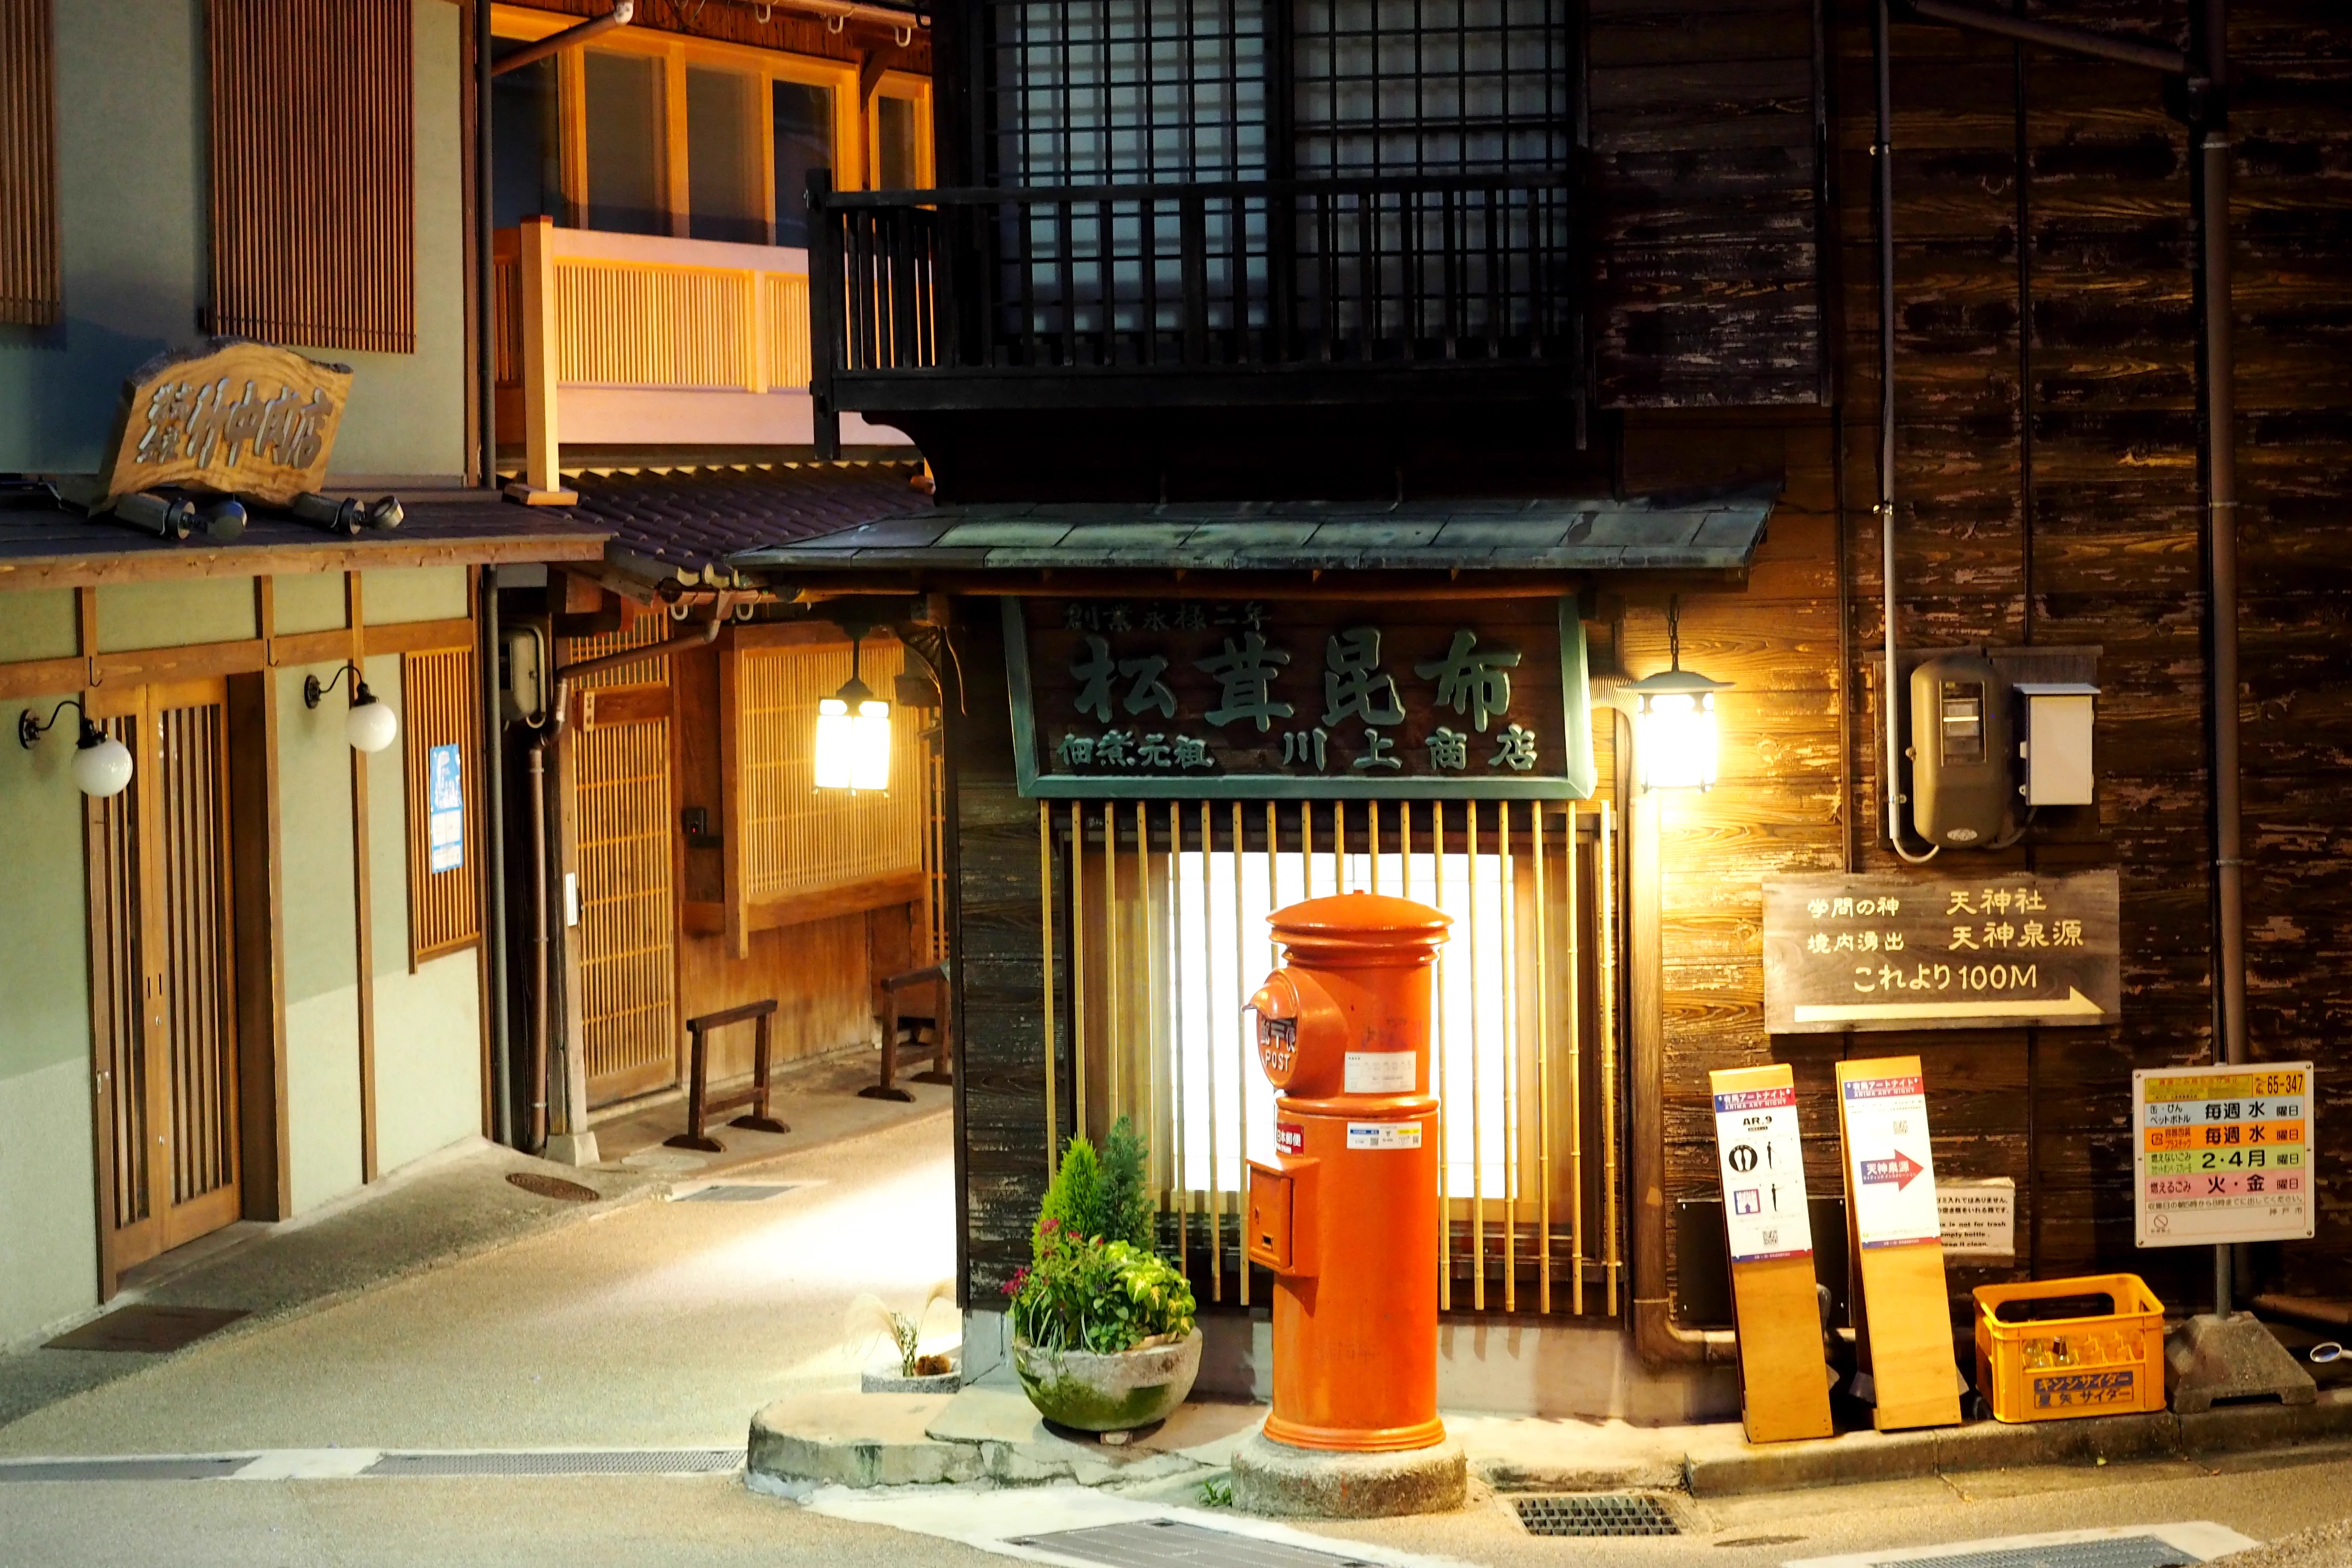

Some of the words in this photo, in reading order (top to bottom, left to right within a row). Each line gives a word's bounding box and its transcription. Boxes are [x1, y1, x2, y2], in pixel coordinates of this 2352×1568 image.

[1069, 627, 1522, 733] 松茸昆布
[1058, 729, 1215, 769] 佃煮元祖
[1283, 723, 1538, 772] 川上商店
[1807, 896, 1900, 919] 学問の神
[1946, 887, 2047, 915] 天神社
[1807, 931, 1904, 954] 境内湧出
[1948, 919, 2084, 951] 天神泉源
[1853, 964, 2037, 992] これより100M
[1265, 1049, 1290, 1072] POST
[2268, 1073, 2303, 1094] 65-347
[1277, 1129, 1301, 1147] 日本郵便
